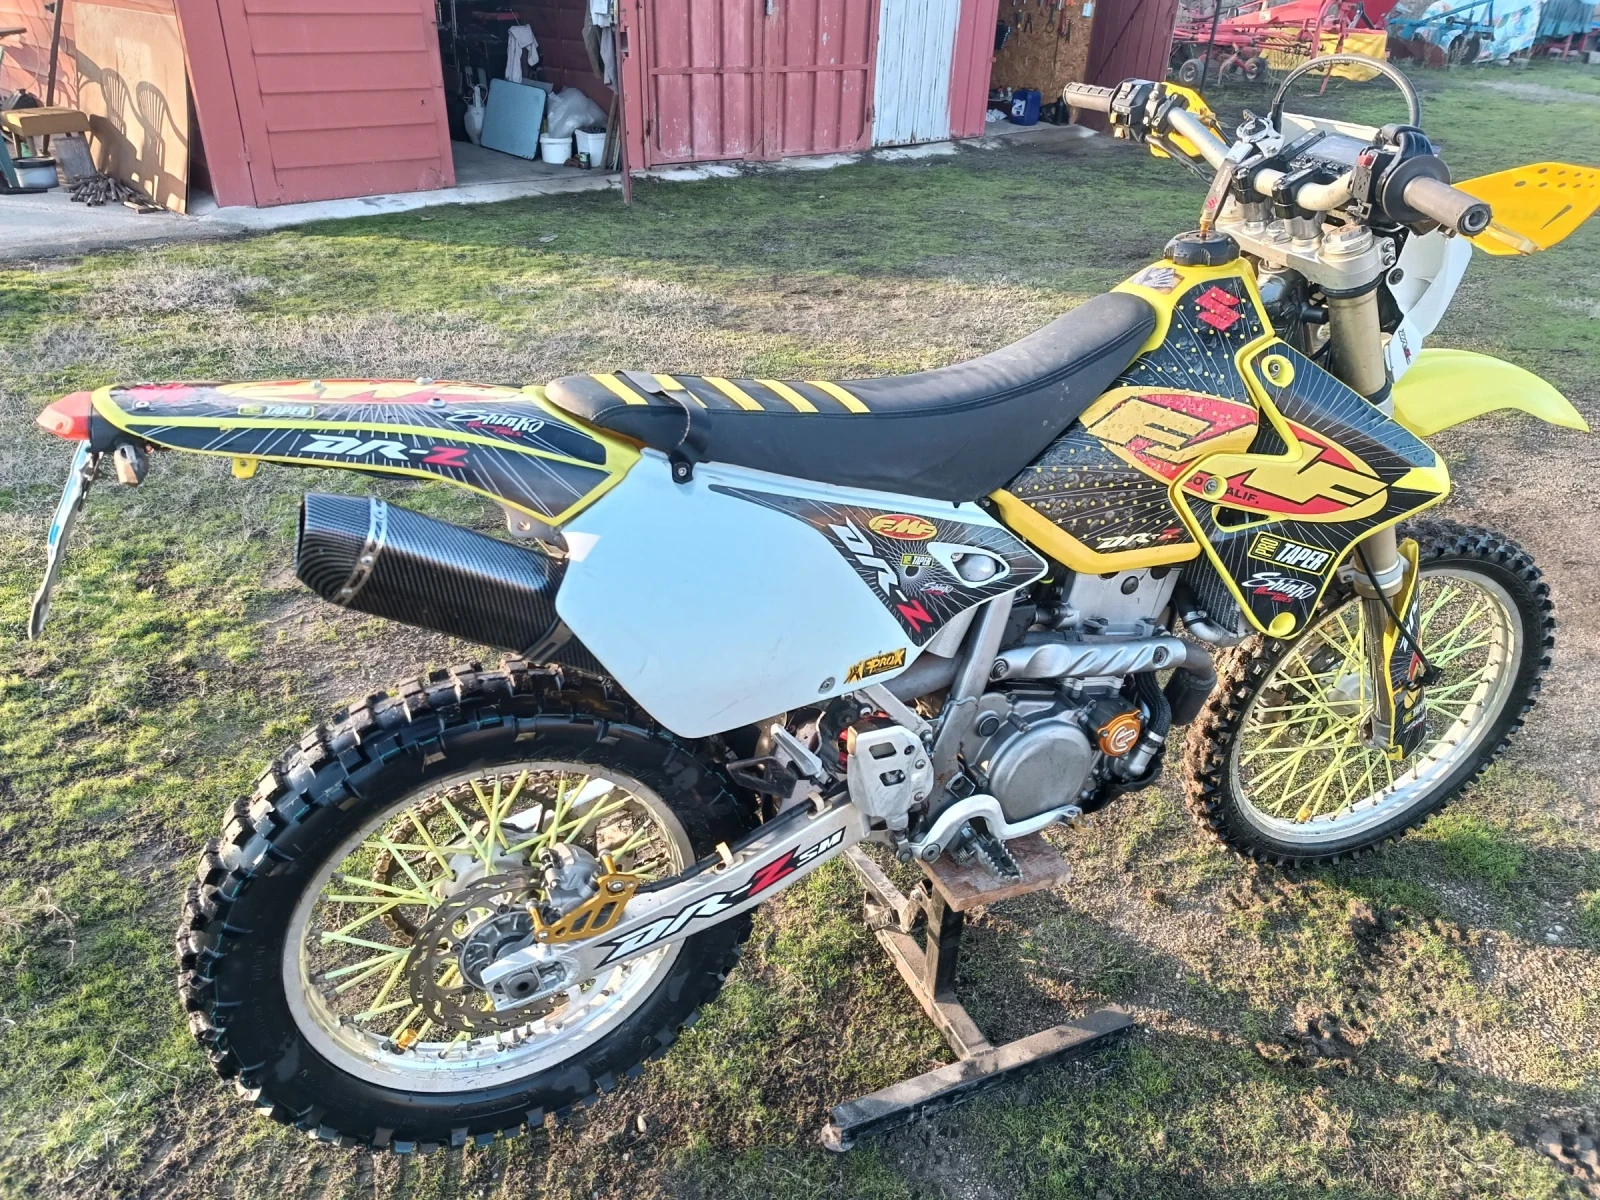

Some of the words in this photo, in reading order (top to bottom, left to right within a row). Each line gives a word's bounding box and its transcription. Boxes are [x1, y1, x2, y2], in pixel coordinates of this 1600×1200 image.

[300, 433, 470, 467] DR-Z
[874, 517, 937, 538] FMF
[1095, 527, 1184, 549] DR-Z
[1254, 537, 1280, 557] PRO
[1274, 542, 1330, 571] TAPER
[828, 516, 933, 633] DR-Z
